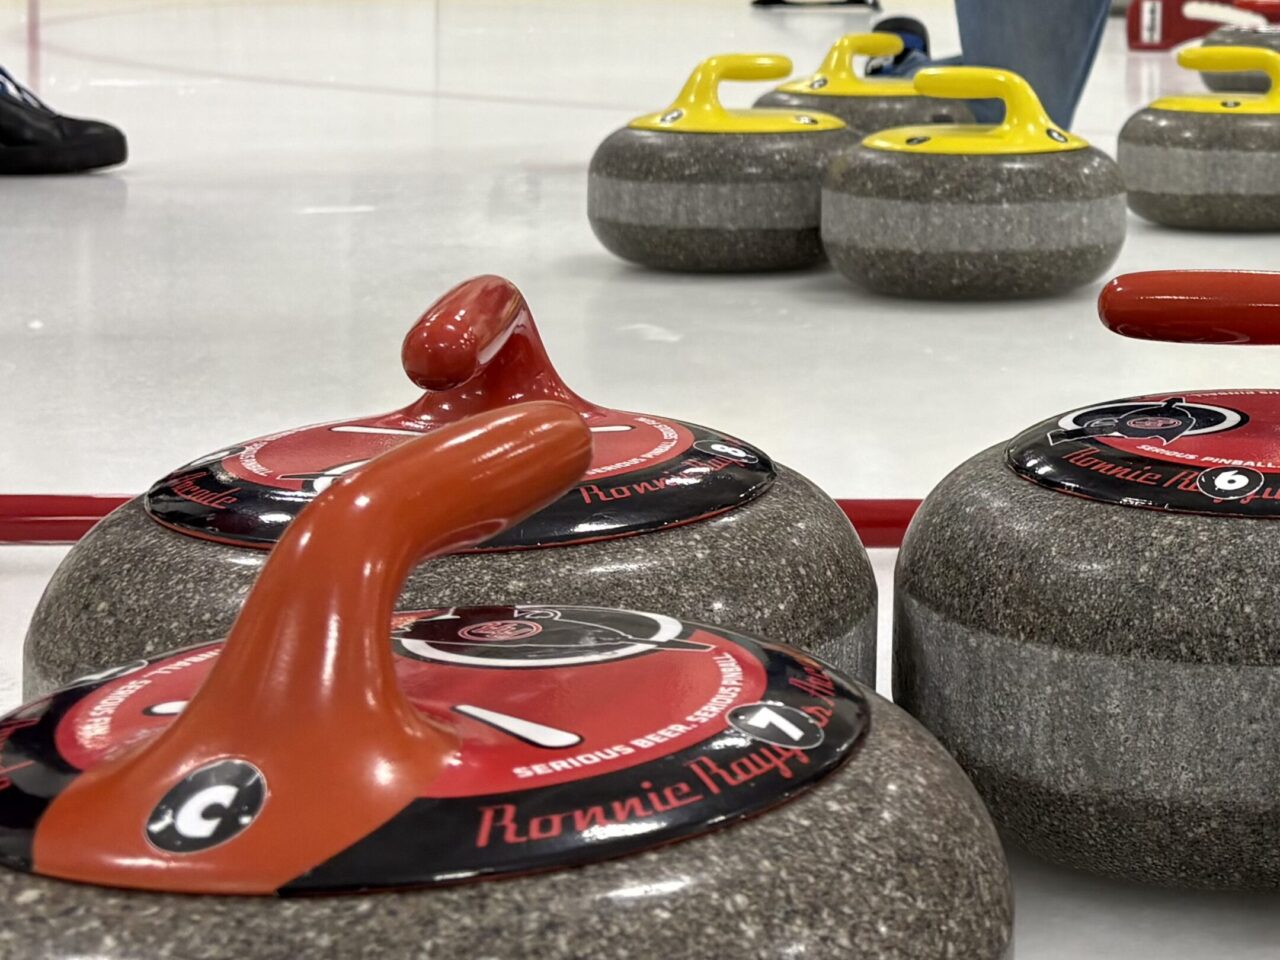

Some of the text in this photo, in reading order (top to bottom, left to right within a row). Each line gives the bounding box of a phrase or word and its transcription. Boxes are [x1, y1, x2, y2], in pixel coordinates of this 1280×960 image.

[710, 443, 747, 459] 8
[1061, 447, 1163, 487] Ronnie
[1135, 443, 1200, 460] SERIOUS
[1213, 469, 1250, 491] 6
[511, 744, 636, 780] SERIOUS
[685, 686, 742, 725] SERIOUS
[747, 706, 805, 742] 7
[174, 784, 240, 838] C
[476, 780, 705, 849] Ronnie
